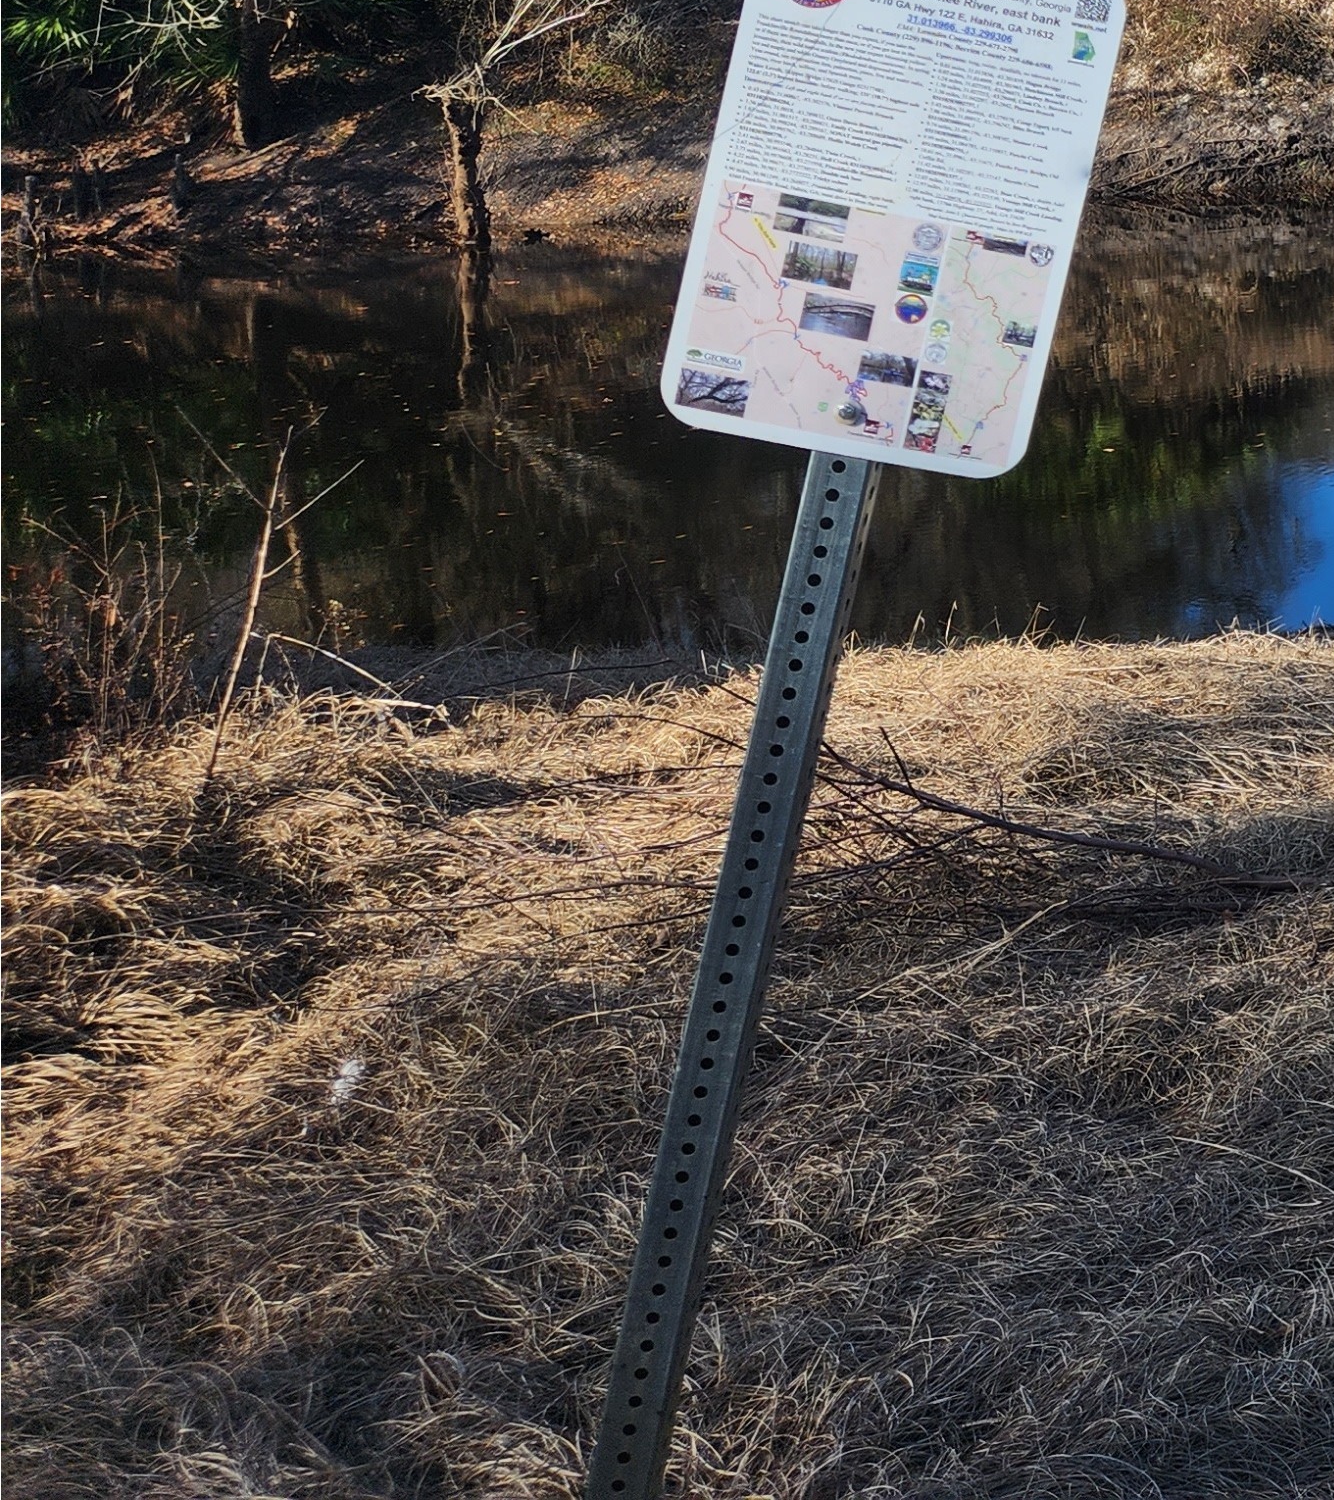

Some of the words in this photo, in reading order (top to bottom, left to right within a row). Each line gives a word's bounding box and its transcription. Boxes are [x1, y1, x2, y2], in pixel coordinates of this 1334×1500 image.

[913, 3, 936, 16] Hwy
[938, 8, 956, 20] 122
[957, 12, 967, 23] E,
[969, 15, 1005, 31] Hahira,
[1024, 26, 1054, 41] 31632
[1001, 7, 1029, 20] east
[1030, 11, 1061, 27] bank
[959, 25, 1013, 44] -83.299306
[703, 352, 742, 367] GEORGIA
